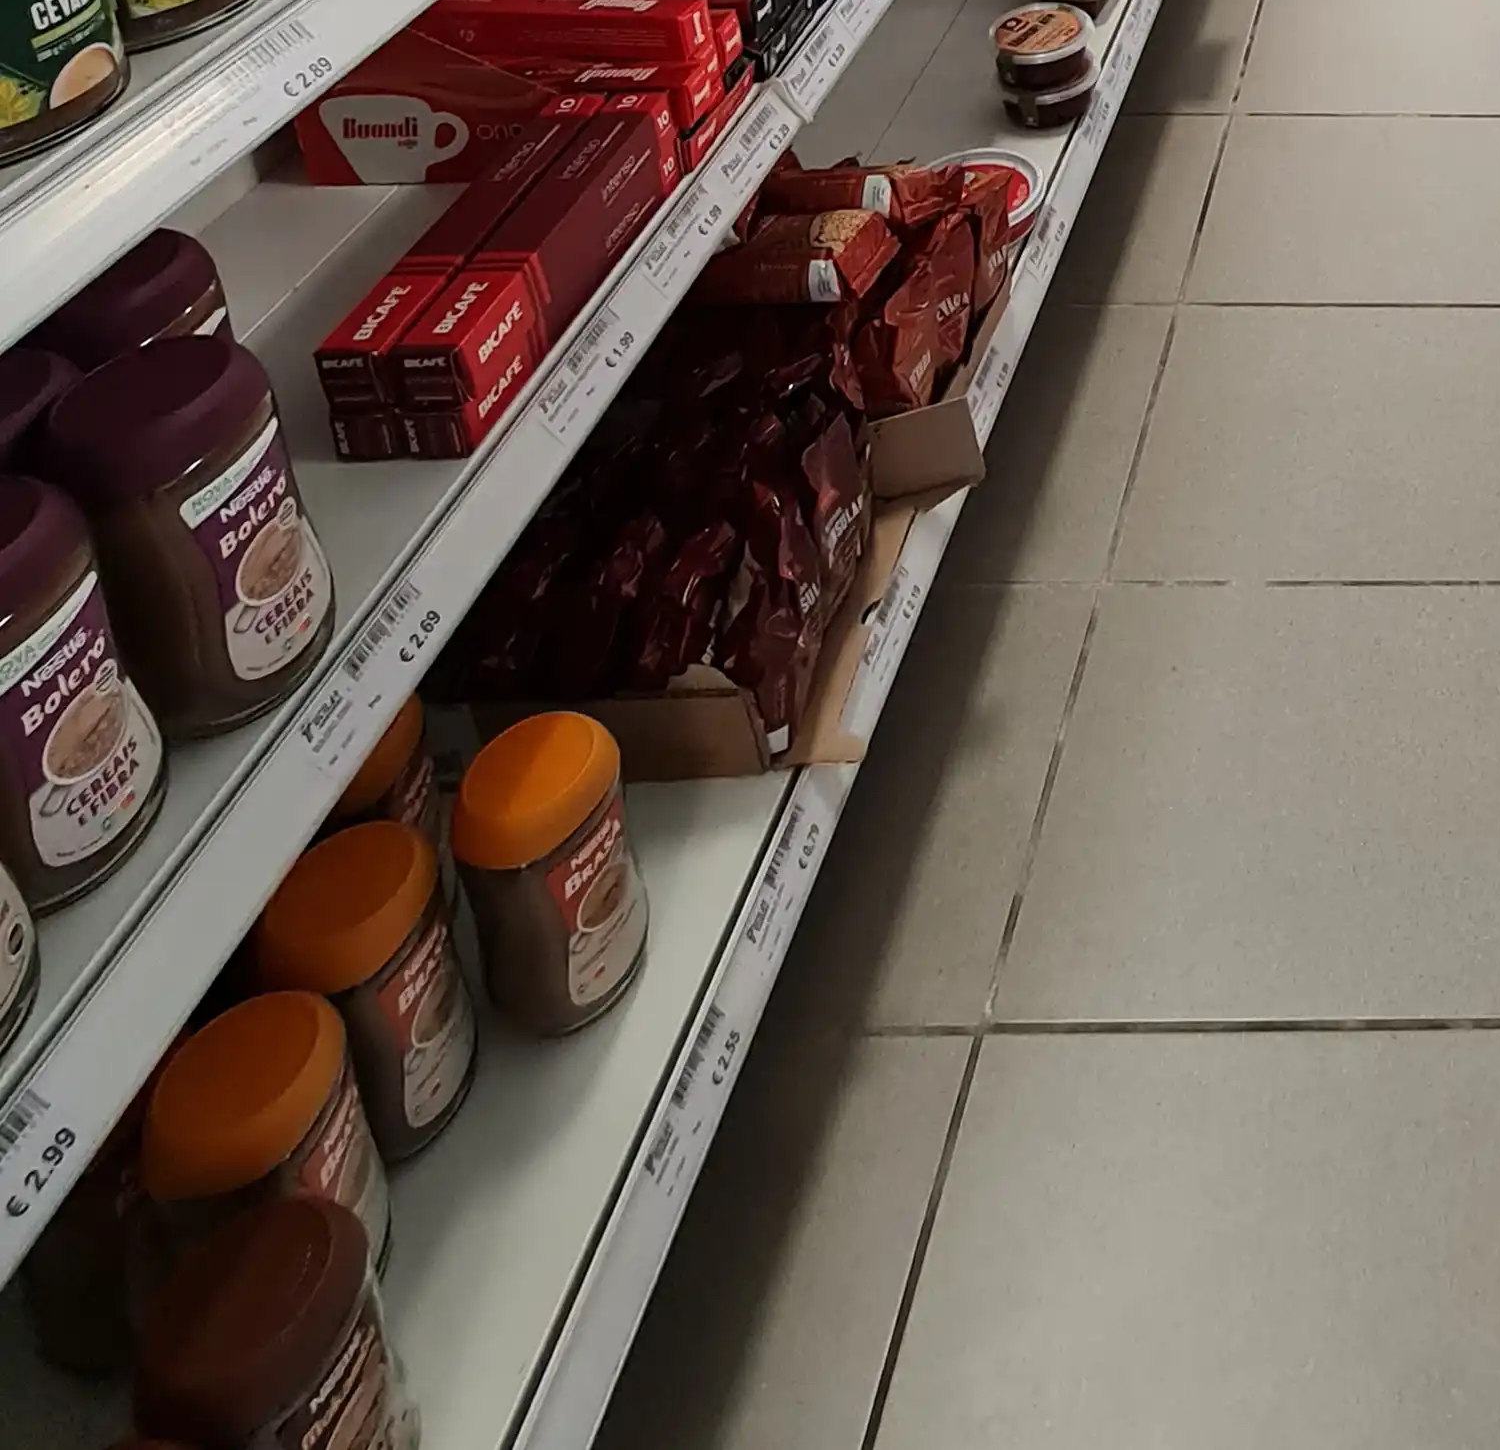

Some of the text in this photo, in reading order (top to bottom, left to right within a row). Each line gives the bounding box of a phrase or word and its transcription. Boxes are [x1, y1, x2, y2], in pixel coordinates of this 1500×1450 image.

[342, 115, 419, 140] Buondi
[219, 474, 289, 559] Bolero
[253, 565, 314, 634] CEREAIS
[20, 634, 107, 738] Bolero
[398, 643, 415, 663] €
[66, 734, 140, 818] CEREAIS
[88, 758, 141, 819] FIBRA
[5, 1126, 77, 1218] € 2.99
